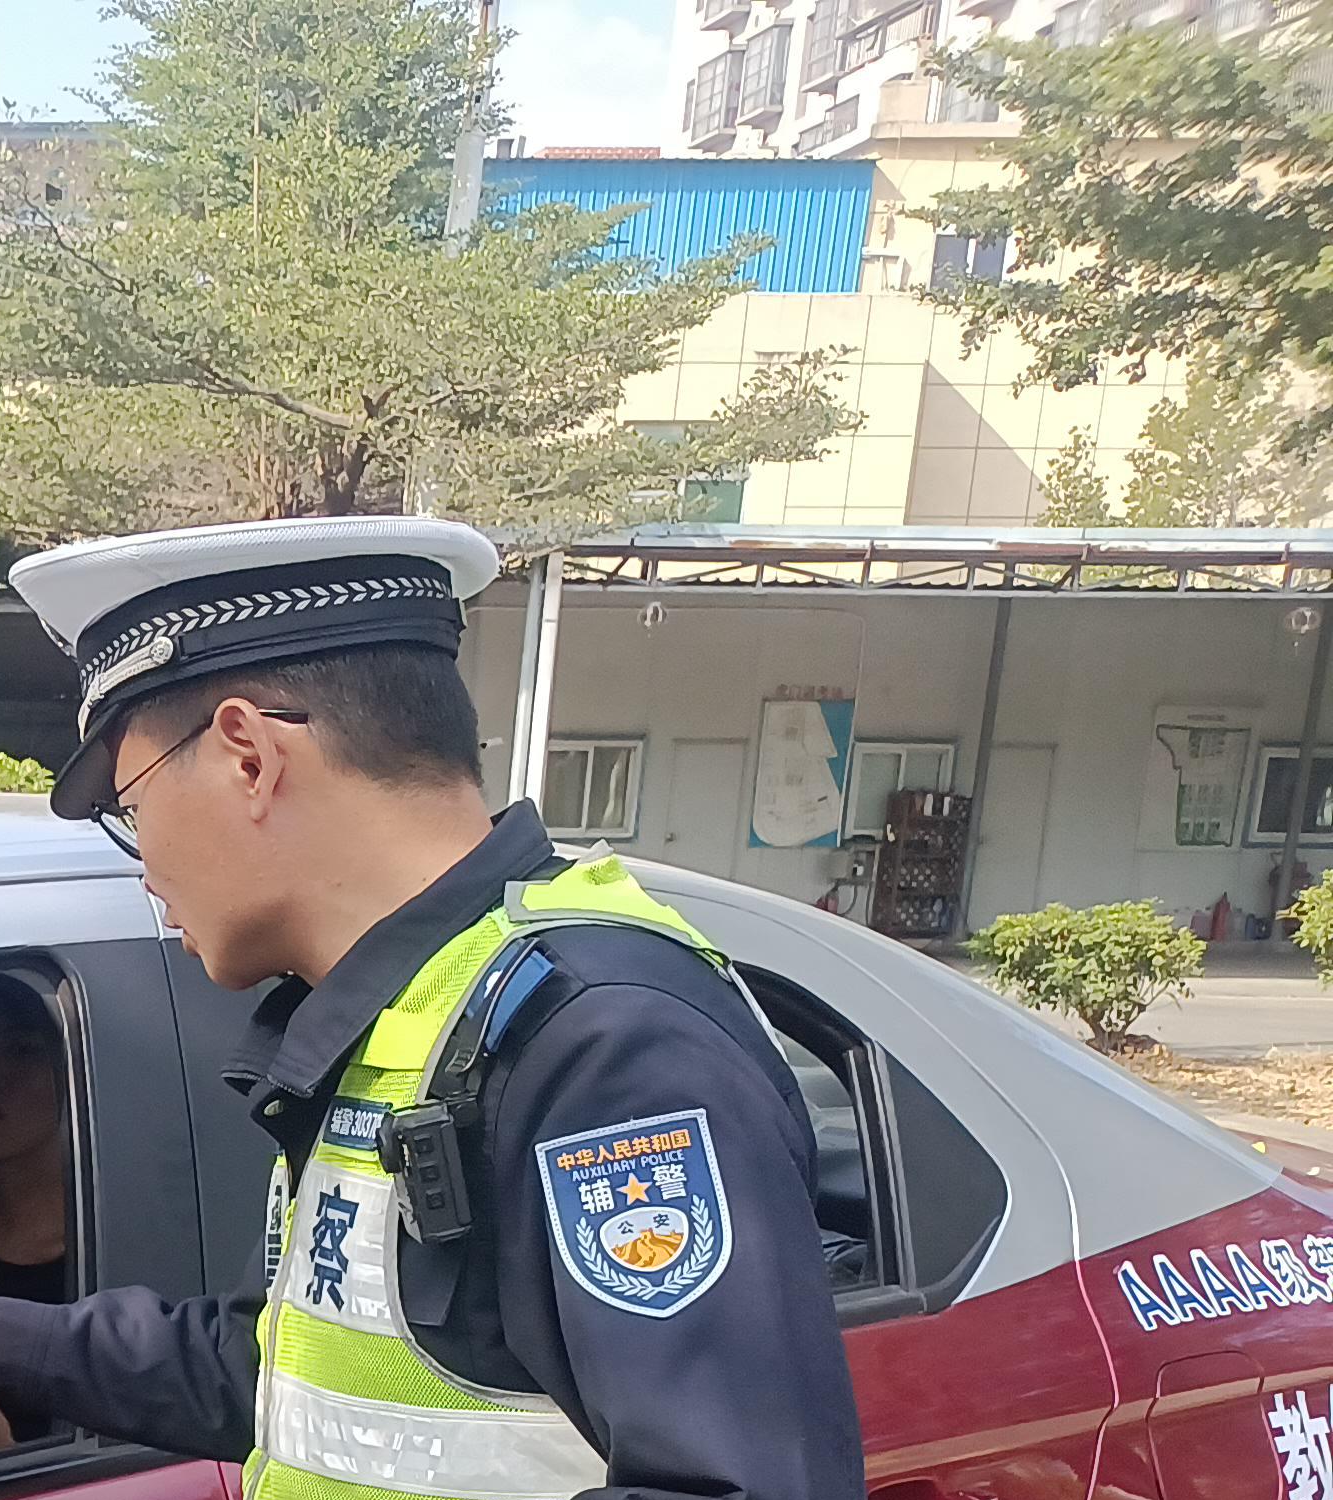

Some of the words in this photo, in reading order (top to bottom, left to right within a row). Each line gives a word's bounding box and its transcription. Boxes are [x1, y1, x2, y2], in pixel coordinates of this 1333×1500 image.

[556, 1128, 692, 1171] 中华人民共和国
[572, 1158, 637, 1182] AUXILIARY
[639, 1148, 686, 1168] POLICE
